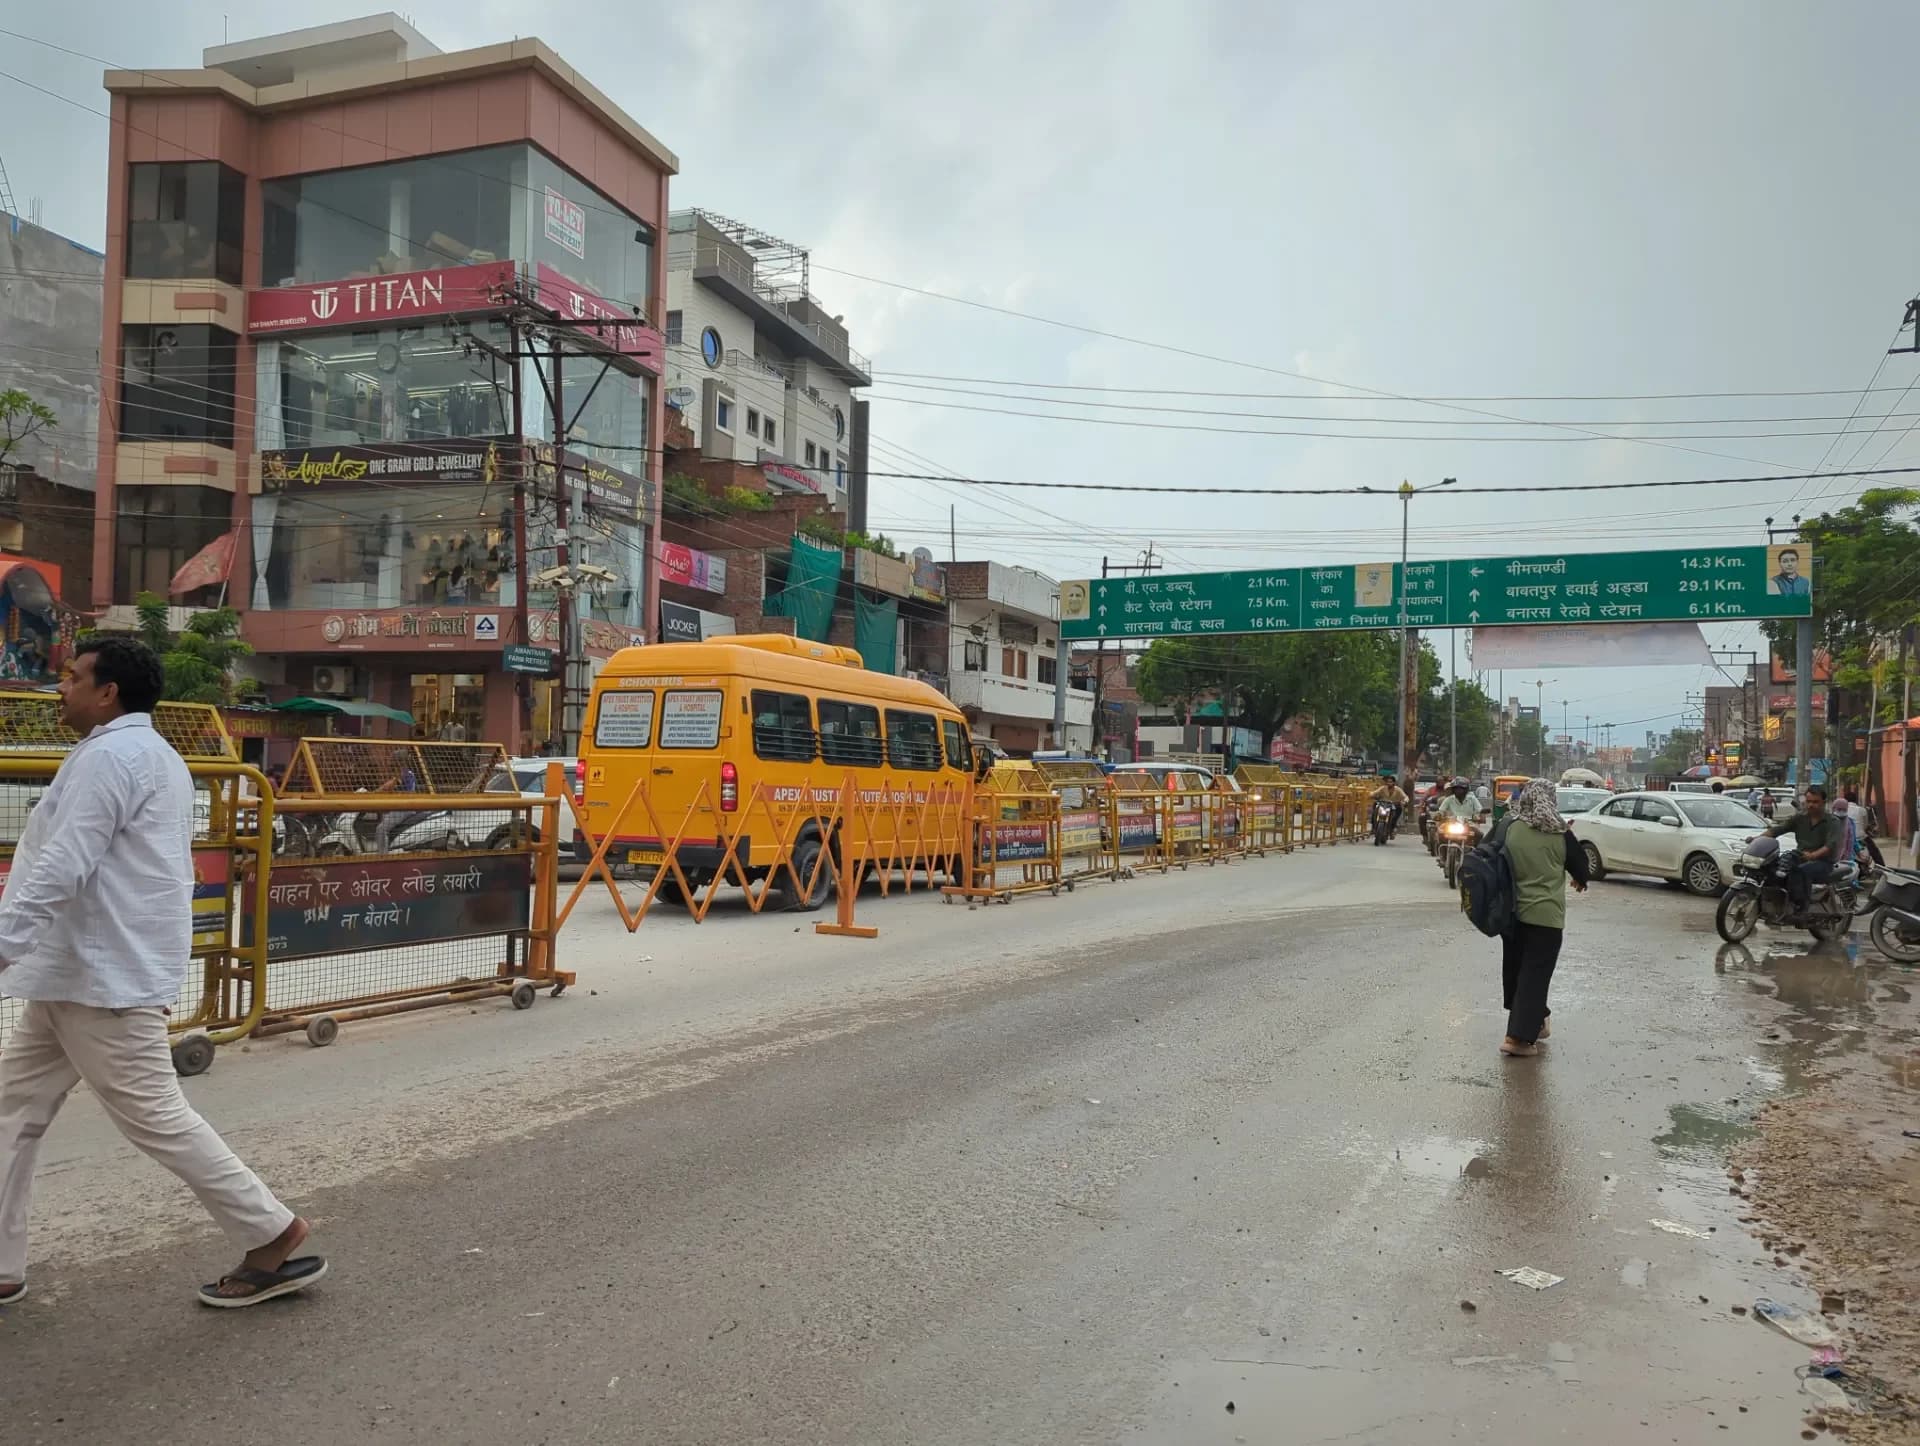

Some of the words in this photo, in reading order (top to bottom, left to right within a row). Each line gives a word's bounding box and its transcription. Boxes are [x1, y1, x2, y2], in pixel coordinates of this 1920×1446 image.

[349, 274, 443, 315] TITAN
[288, 452, 342, 484] Angel
[369, 459, 385, 474] ONE
[387, 457, 412, 473] GRAM
[414, 456, 434, 472] GOLD
[435, 453, 483, 471] JEWELLERY
[1506, 558, 1567, 576] भीमचण्डी
[1680, 557, 1711, 569] 14.3
[1714, 555, 1746, 567] Km.
[1248, 578, 1262, 589] 2.1
[1266, 576, 1289, 587] Km.
[1506, 584, 1557, 600] बाबतपुर
[1565, 580, 1599, 597] हवाई
[1679, 580, 1709, 592] 29.1
[1714, 579, 1746, 591] Km.
[1150, 598, 1173, 612] रेलवे
[1180, 597, 1212, 611] स्टेशन
[1248, 597, 1263, 608] 7.5
[1266, 597, 1289, 608] Km.
[1506, 607, 1551, 619] बनारस
[1560, 602, 1591, 618] रेलवे
[1599, 601, 1642, 617] स्टेशन
[1689, 603, 1710, 614] 6.1
[1714, 602, 1746, 614] Km.
[667, 618, 698, 634] JOCKEY
[1124, 620, 1163, 633] सारनाथ
[1200, 618, 1225, 630] स्थल
[1250, 617, 1263, 628] 16
[1266, 617, 1290, 628] Km.
[1315, 615, 1343, 627] लोक
[1350, 613, 1389, 626] निर्माण
[1397, 613, 1434, 625] िभाग
[618, 677, 656, 688] SCHOOL
[774, 788, 801, 801] APEX
[270, 883, 312, 906] वाहन
[318, 881, 343, 900] पर
[352, 870, 391, 897] ओवर
[402, 868, 437, 896] लोड
[442, 864, 483, 892] सवारी
[341, 912, 359, 929] ना
[268, 941, 289, 951] 073
